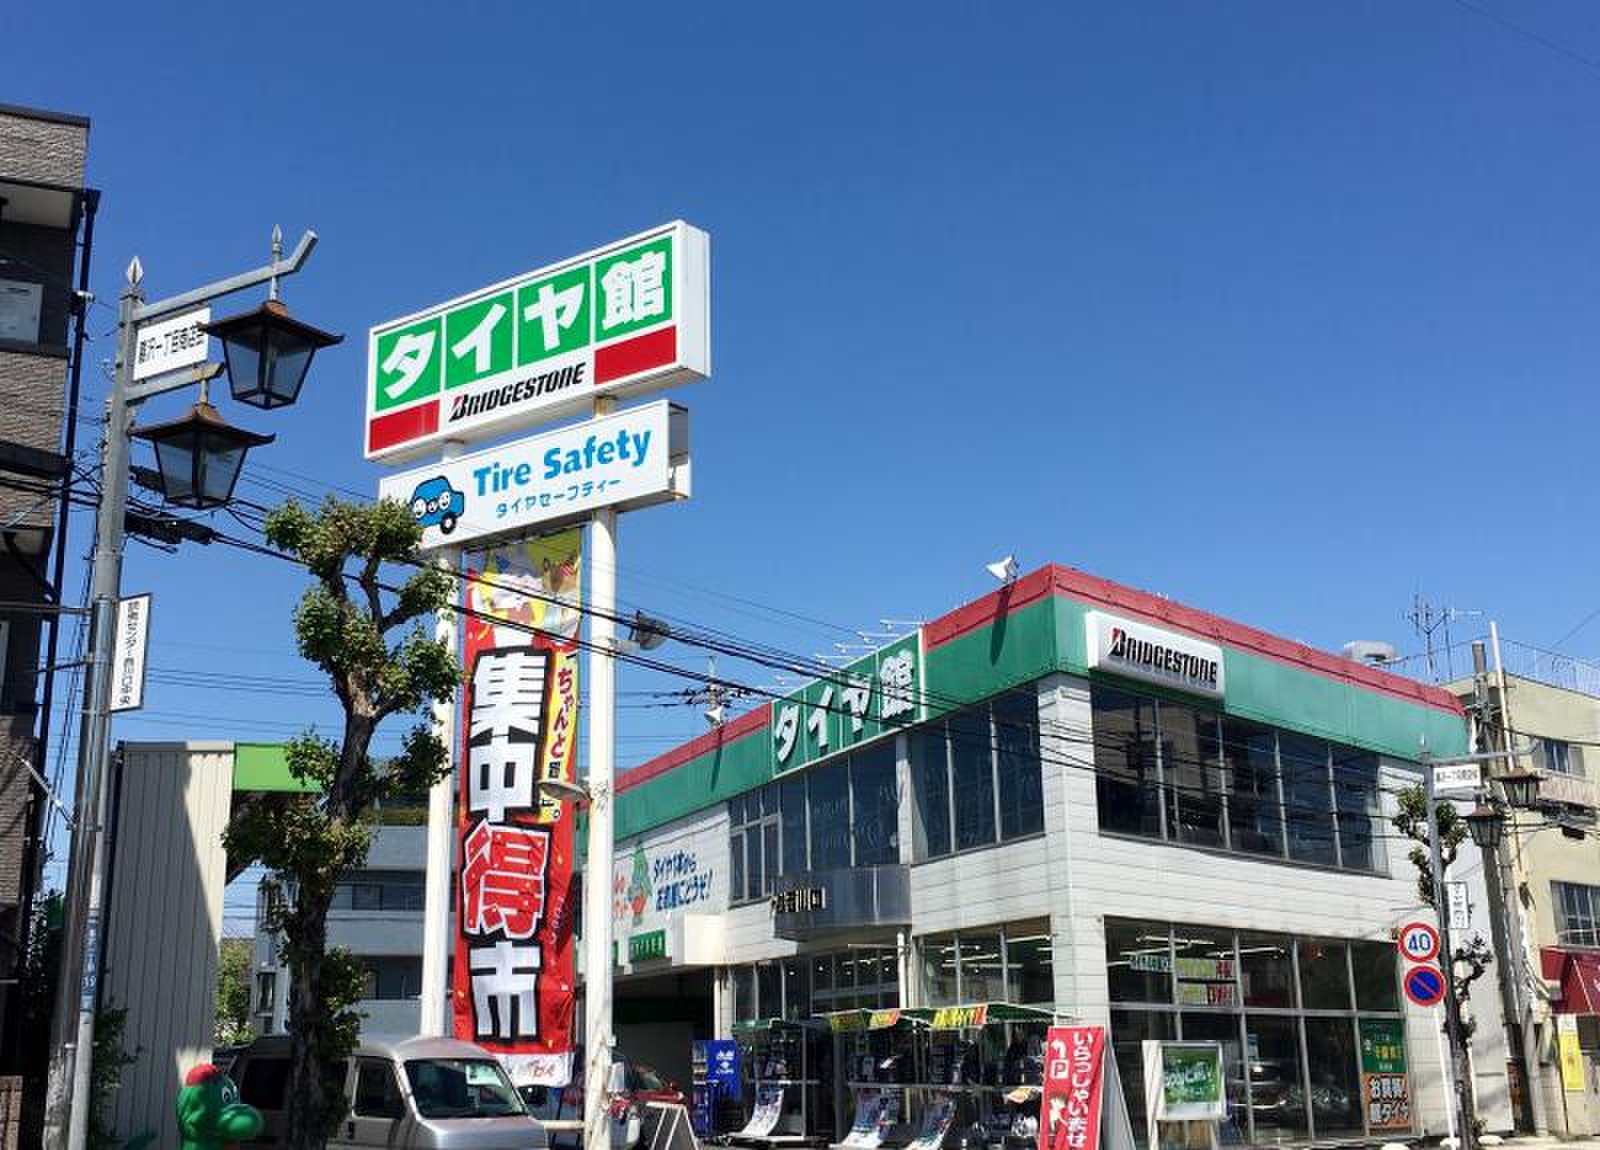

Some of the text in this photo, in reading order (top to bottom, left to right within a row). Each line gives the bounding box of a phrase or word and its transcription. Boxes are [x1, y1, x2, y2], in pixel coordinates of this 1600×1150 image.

[381, 250, 667, 399] タイヤ館
[448, 361, 587, 422] BRIDGESTONE
[472, 429, 653, 497] Tire Safety
[495, 478, 623, 519] タイヤセーフティー
[1108, 627, 1218, 683] BRIDGESTONE
[774, 648, 915, 764] タイヤ館
[1407, 933, 1431, 951] 40
[1066, 1031, 1094, 1149] いらっしゃいませ
